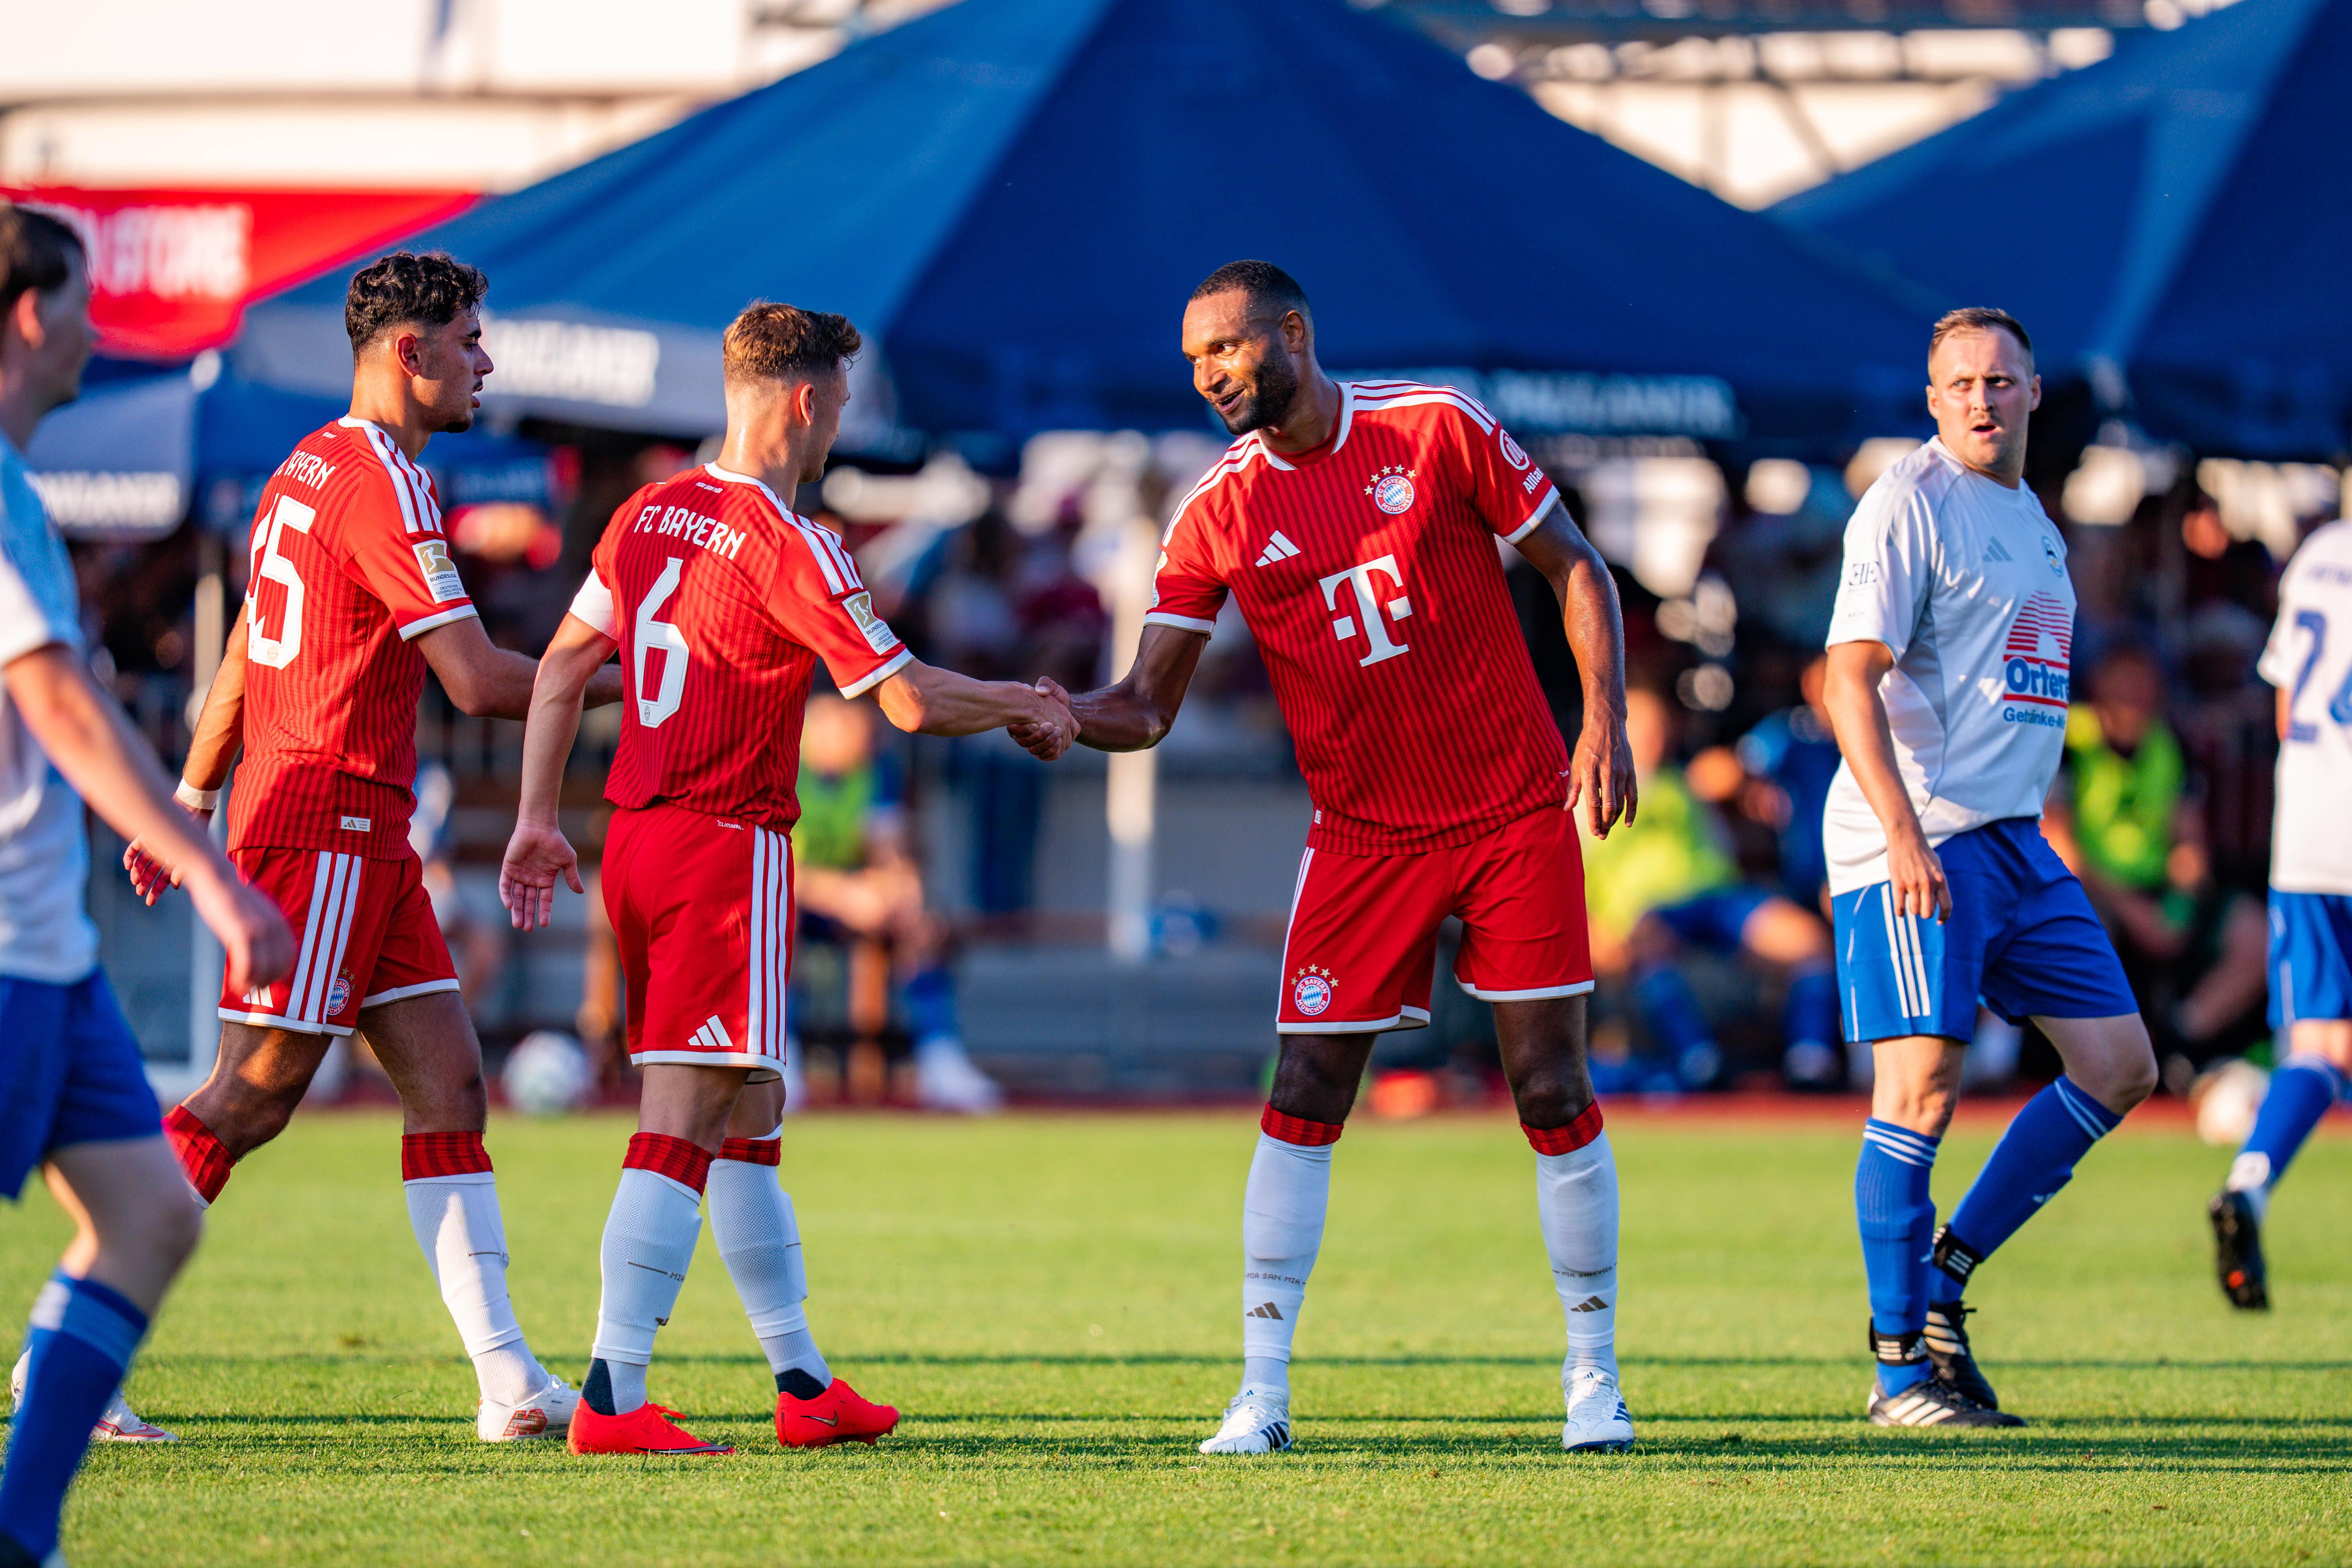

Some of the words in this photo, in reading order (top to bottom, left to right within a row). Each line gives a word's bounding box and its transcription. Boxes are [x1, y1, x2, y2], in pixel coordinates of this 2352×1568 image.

[1378, 488, 1384, 498] FC
[1381, 478, 1409, 488] BAYERN
[634, 505, 661, 534] FC
[657, 506, 747, 560] BAYERN
[429, 574, 457, 582] BUNDESLIGA
[634, 556, 690, 729] 6
[717, 821, 742, 830] CLIMACOOL
[1298, 984, 1305, 993] FC
[1304, 978, 1328, 994] BAYERN
[1262, 1273, 1281, 1281] SAN
[1284, 1276, 1300, 1285] MIA
